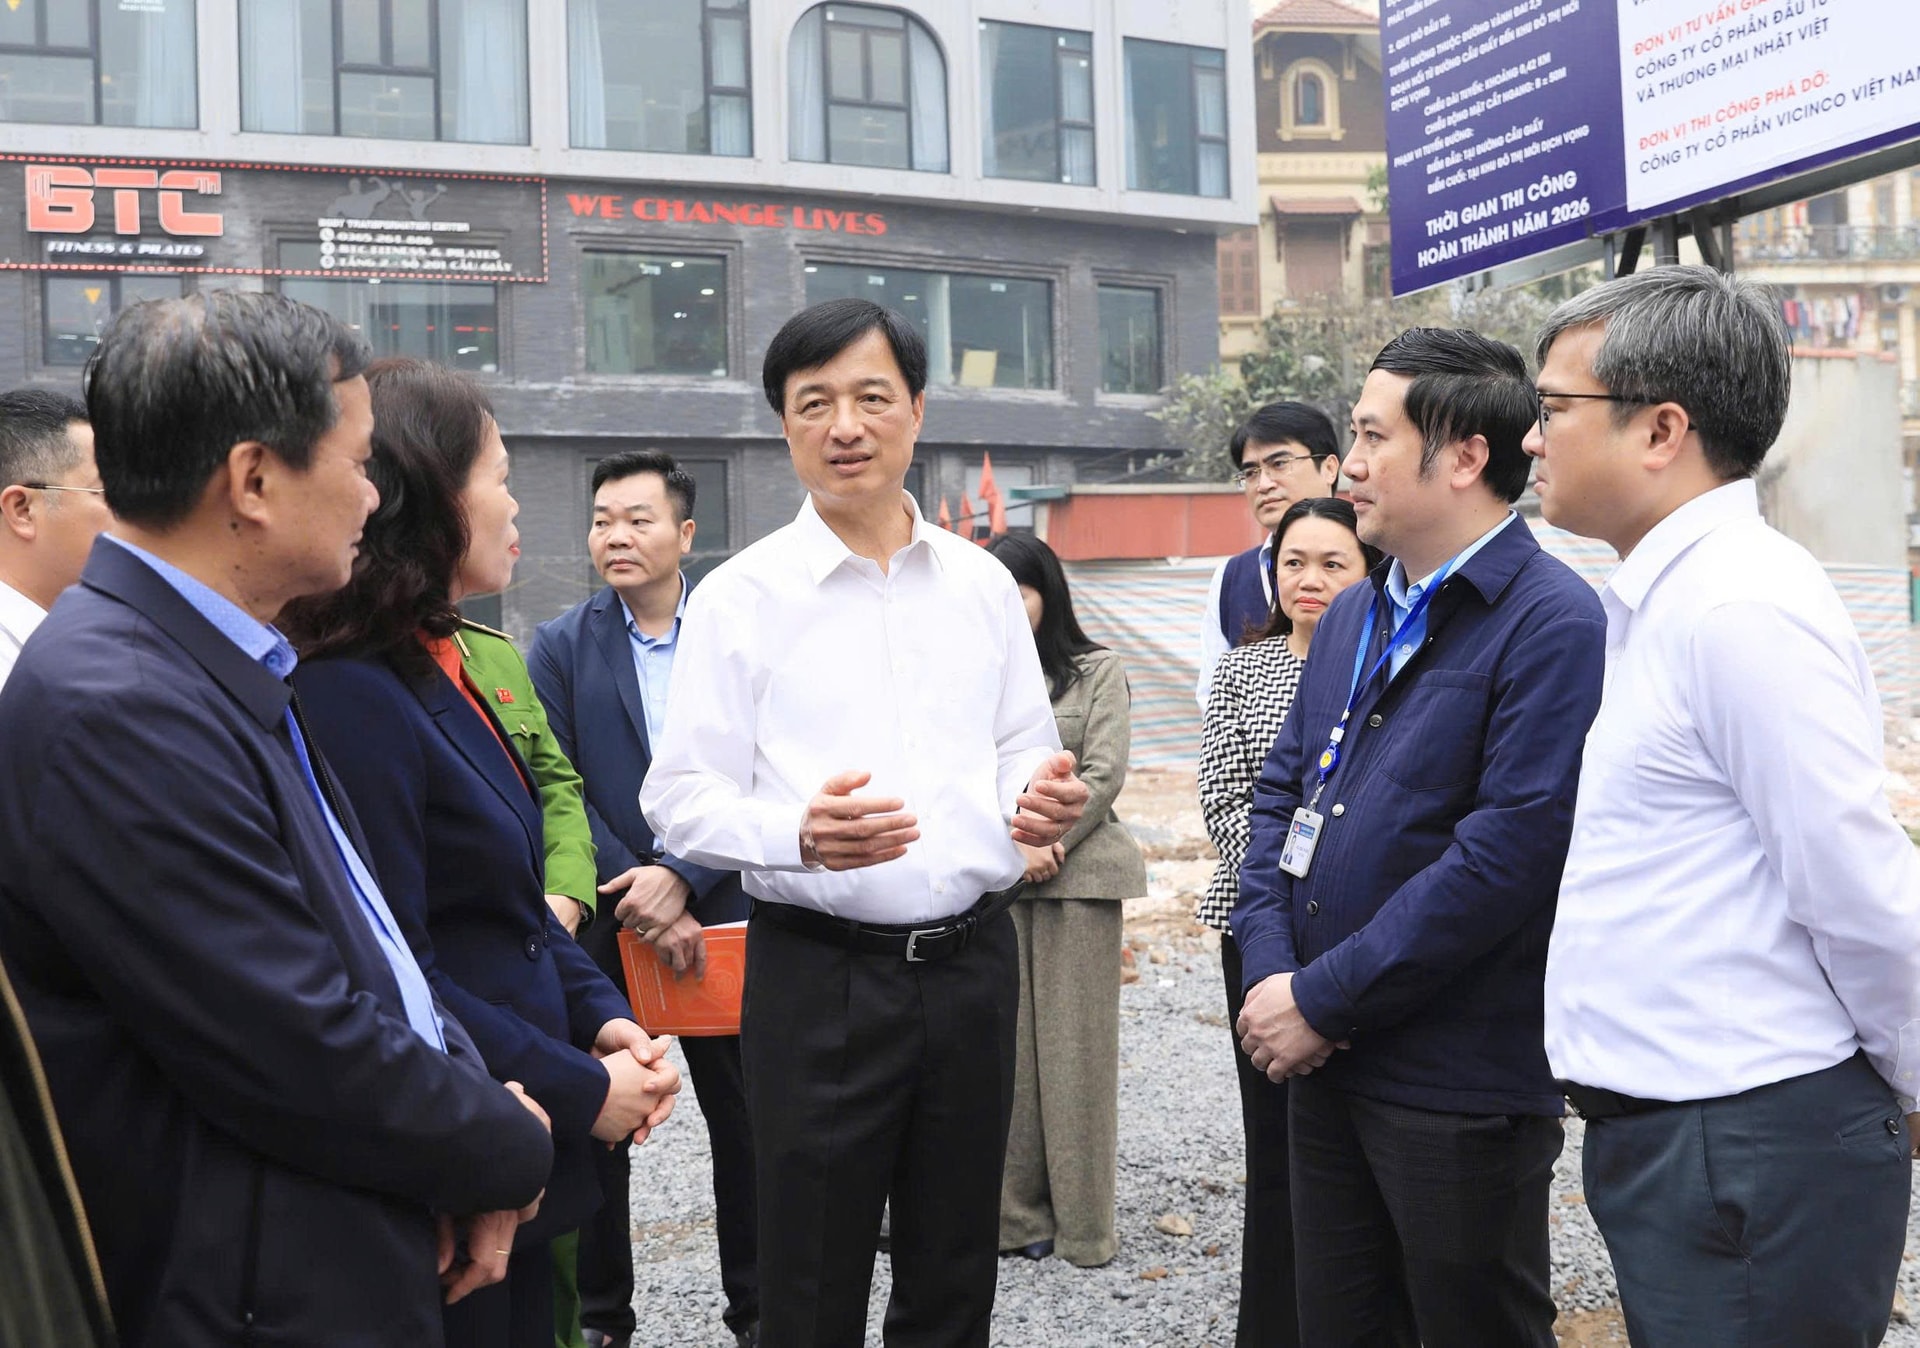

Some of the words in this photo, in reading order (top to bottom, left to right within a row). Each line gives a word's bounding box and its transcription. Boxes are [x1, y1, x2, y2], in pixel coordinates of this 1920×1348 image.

[1636, 53, 1677, 79] CÔNG
[1682, 44, 1696, 60] TY
[1701, 27, 1723, 53] CỔ
[1636, 84, 1655, 103] VÀ
[1722, 49, 1748, 70] MẠI
[1798, 17, 1829, 40] VIỆT
[1640, 150, 1681, 174] CÔNG
[1686, 142, 1700, 158] TY
[1705, 126, 1727, 151] CỔ
[1777, 92, 1846, 127] VICINCO
[1852, 77, 1885, 101] VIỆT
[1690, 114, 1711, 132] THI
[1715, 99, 1760, 122] CÔNG
[25, 164, 224, 237] BTC
[565, 193, 624, 220] WE
[632, 198, 786, 228] CHANGE
[793, 207, 888, 236] LIVES
[1417, 240, 1458, 268] HOÀN
[1460, 223, 1509, 252] THÀNH
[1512, 210, 1548, 238] NĂM
[1551, 197, 1590, 225] 2026
[1425, 210, 1459, 236] THỜI
[1461, 197, 1498, 224] GIAN
[1501, 188, 1524, 211] THI
[1527, 170, 1577, 201] CÔNG
[47, 241, 116, 254] FITNESS
[119, 243, 133, 254] &
[137, 243, 204, 256] PILATES
